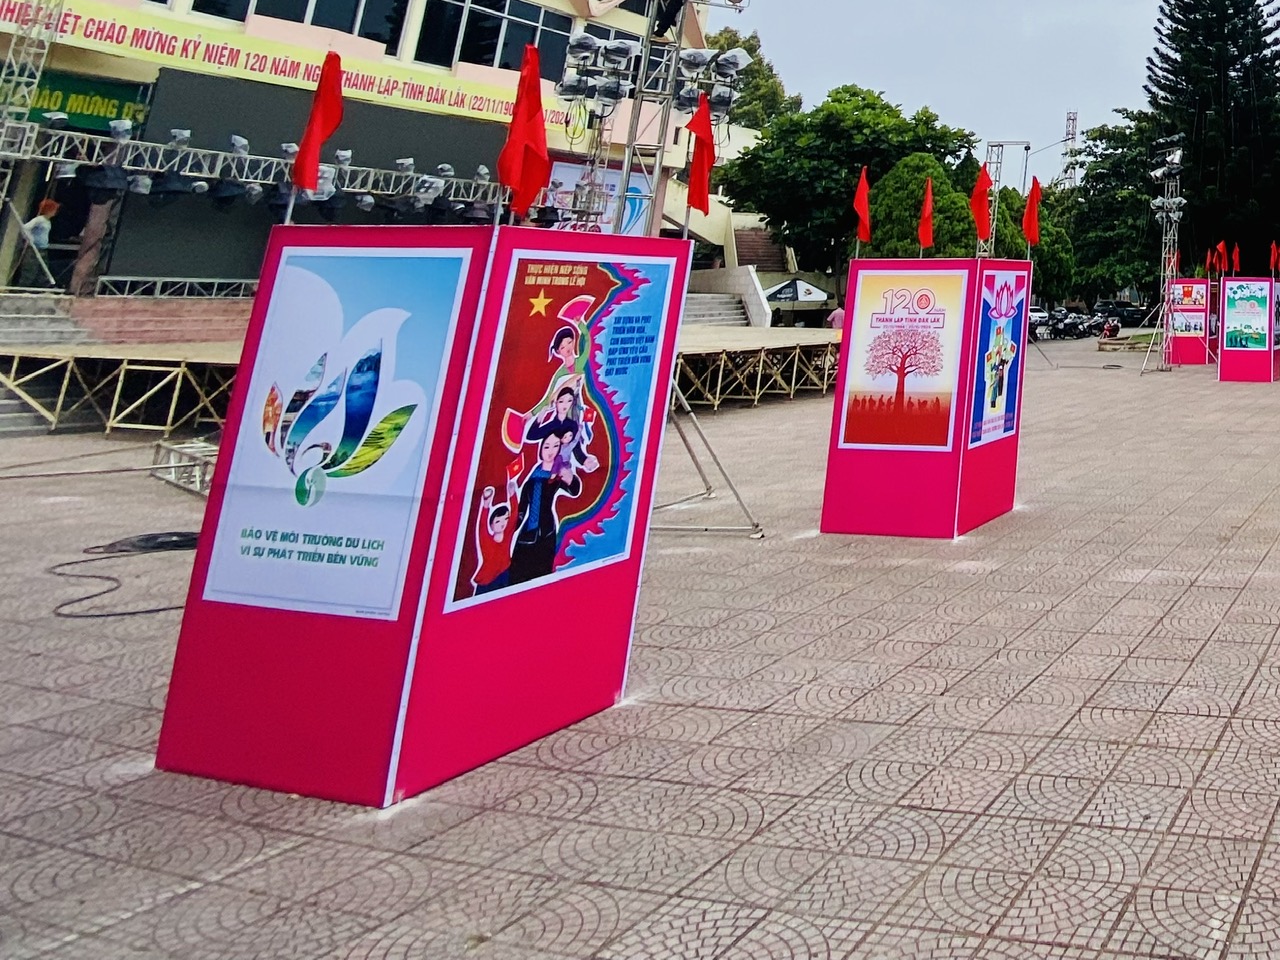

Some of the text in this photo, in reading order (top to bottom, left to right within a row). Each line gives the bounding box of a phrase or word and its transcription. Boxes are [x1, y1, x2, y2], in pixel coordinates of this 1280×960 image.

[83, 17, 127, 45] CHÀO
[129, 25, 178, 56] MỪNG
[180, 33, 202, 60] KỶ
[202, 42, 241, 70] NIỆM
[243, 52, 268, 73] 120
[269, 56, 301, 79] NĂM
[377, 76, 399, 99] LẬP
[400, 77, 425, 101] TỈNH
[426, 82, 446, 104] ĐẮK
[448, 85, 467, 109] LẮK
[66, 91, 119, 118] MỪNG
[883, 288, 935, 314] 120
[345, 537, 360, 548] DU
